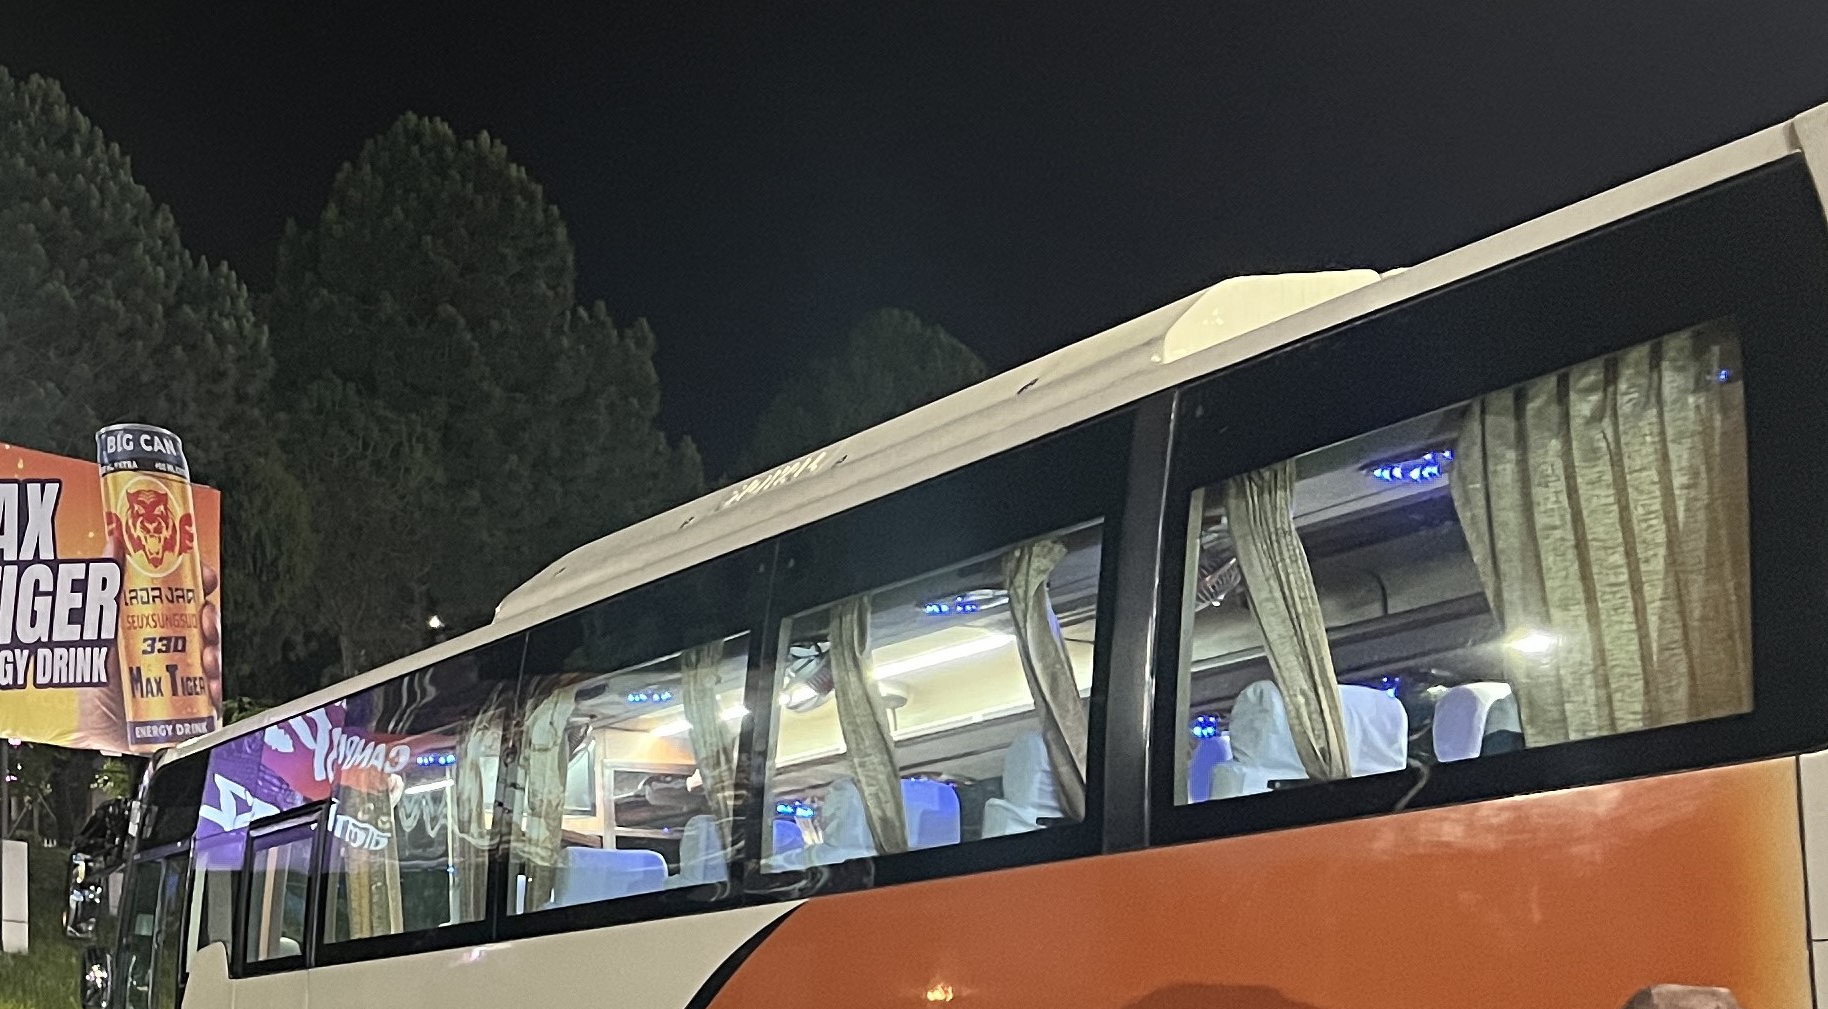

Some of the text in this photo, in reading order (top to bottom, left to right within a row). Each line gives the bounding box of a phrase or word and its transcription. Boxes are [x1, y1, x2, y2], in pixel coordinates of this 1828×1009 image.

[107, 433, 177, 456] BIG CAN
[36, 647, 108, 684] DRINK
[135, 722, 208, 738] ENERGY DRINK
